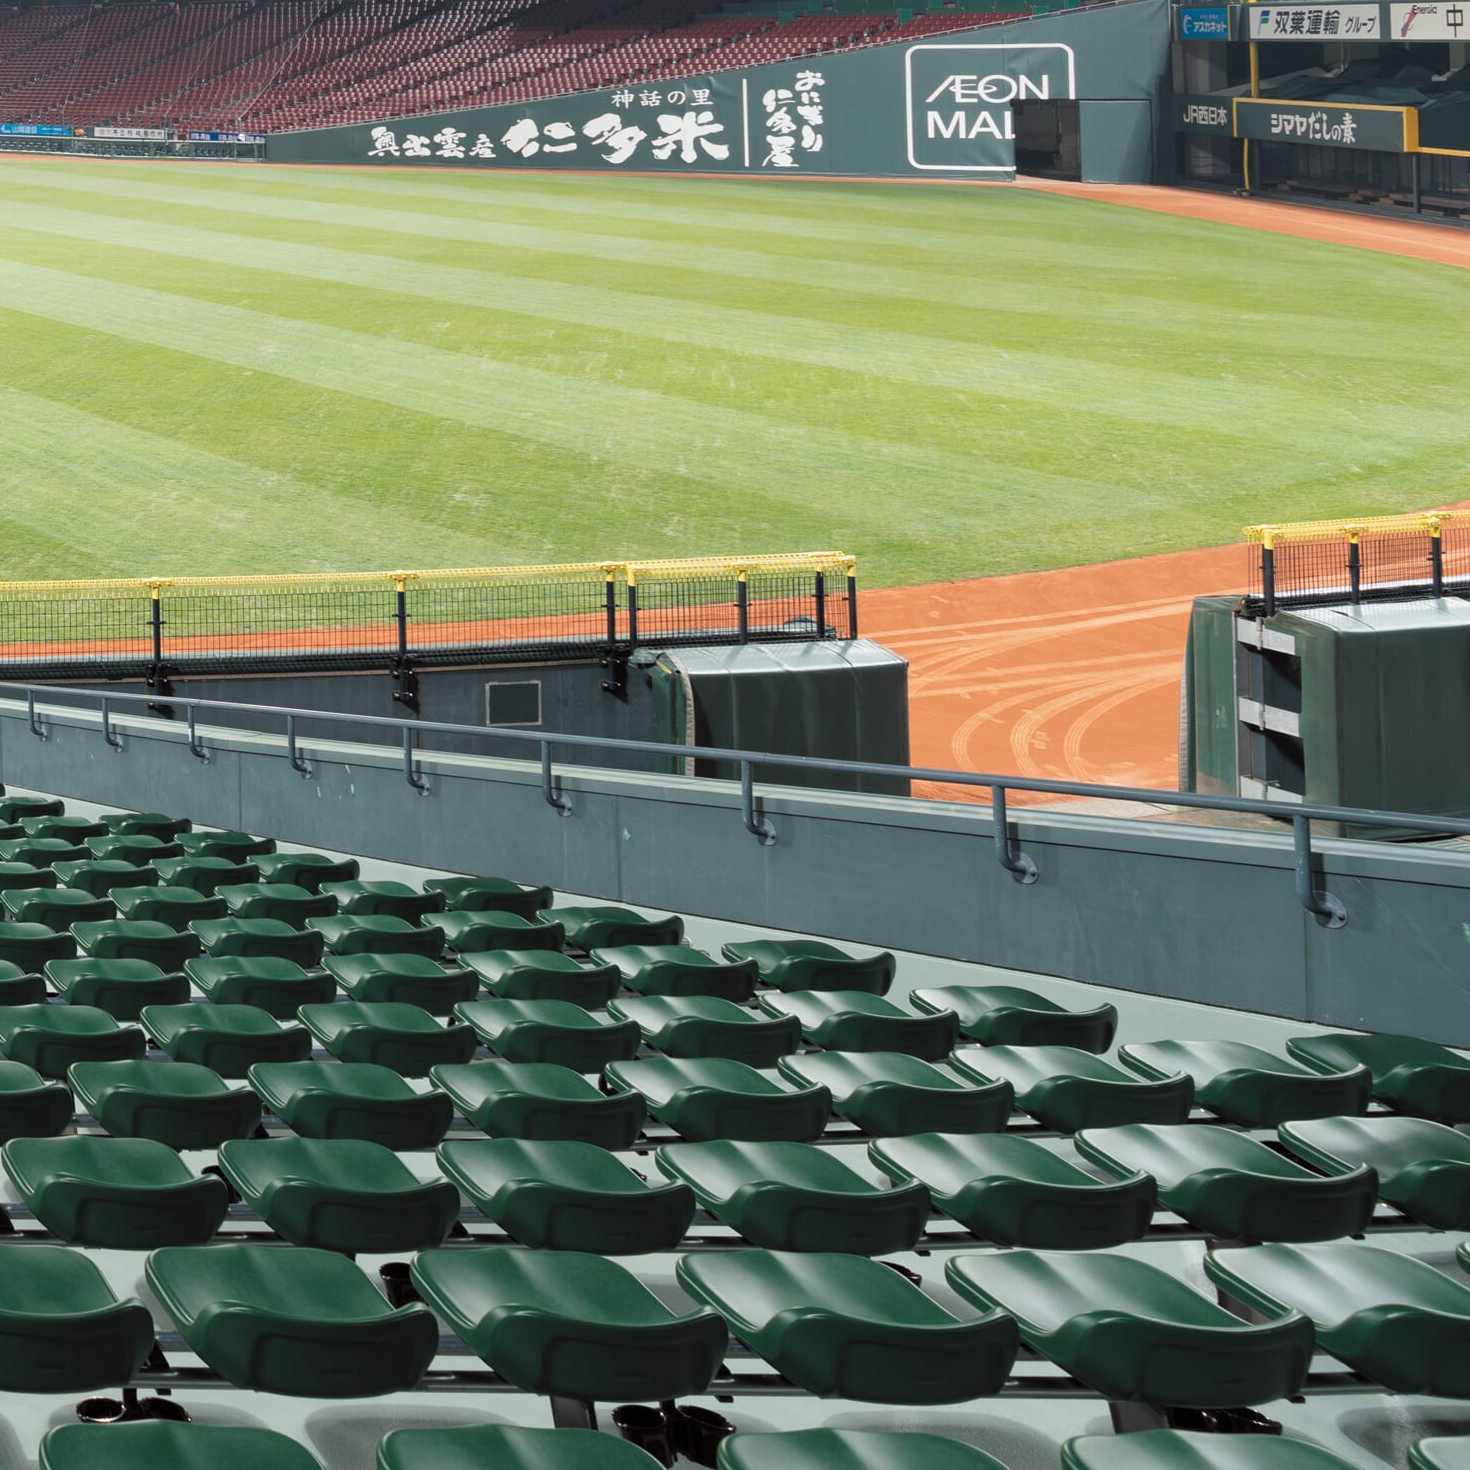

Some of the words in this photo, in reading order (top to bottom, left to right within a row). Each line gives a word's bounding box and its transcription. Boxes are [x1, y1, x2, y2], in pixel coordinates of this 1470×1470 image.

[1412, 5, 1437, 15] Energia
[1193, 21, 1228, 33] アスカネット
[1274, 10, 1340, 35] 双葉運輸
[1345, 17, 1377, 34] グループ
[1446, 4, 1463, 38] 中
[612, 88, 714, 108] 神話の里
[1183, 105, 1228, 126] JR西日本
[1270, 112, 1357, 144] シマヤだしの素
